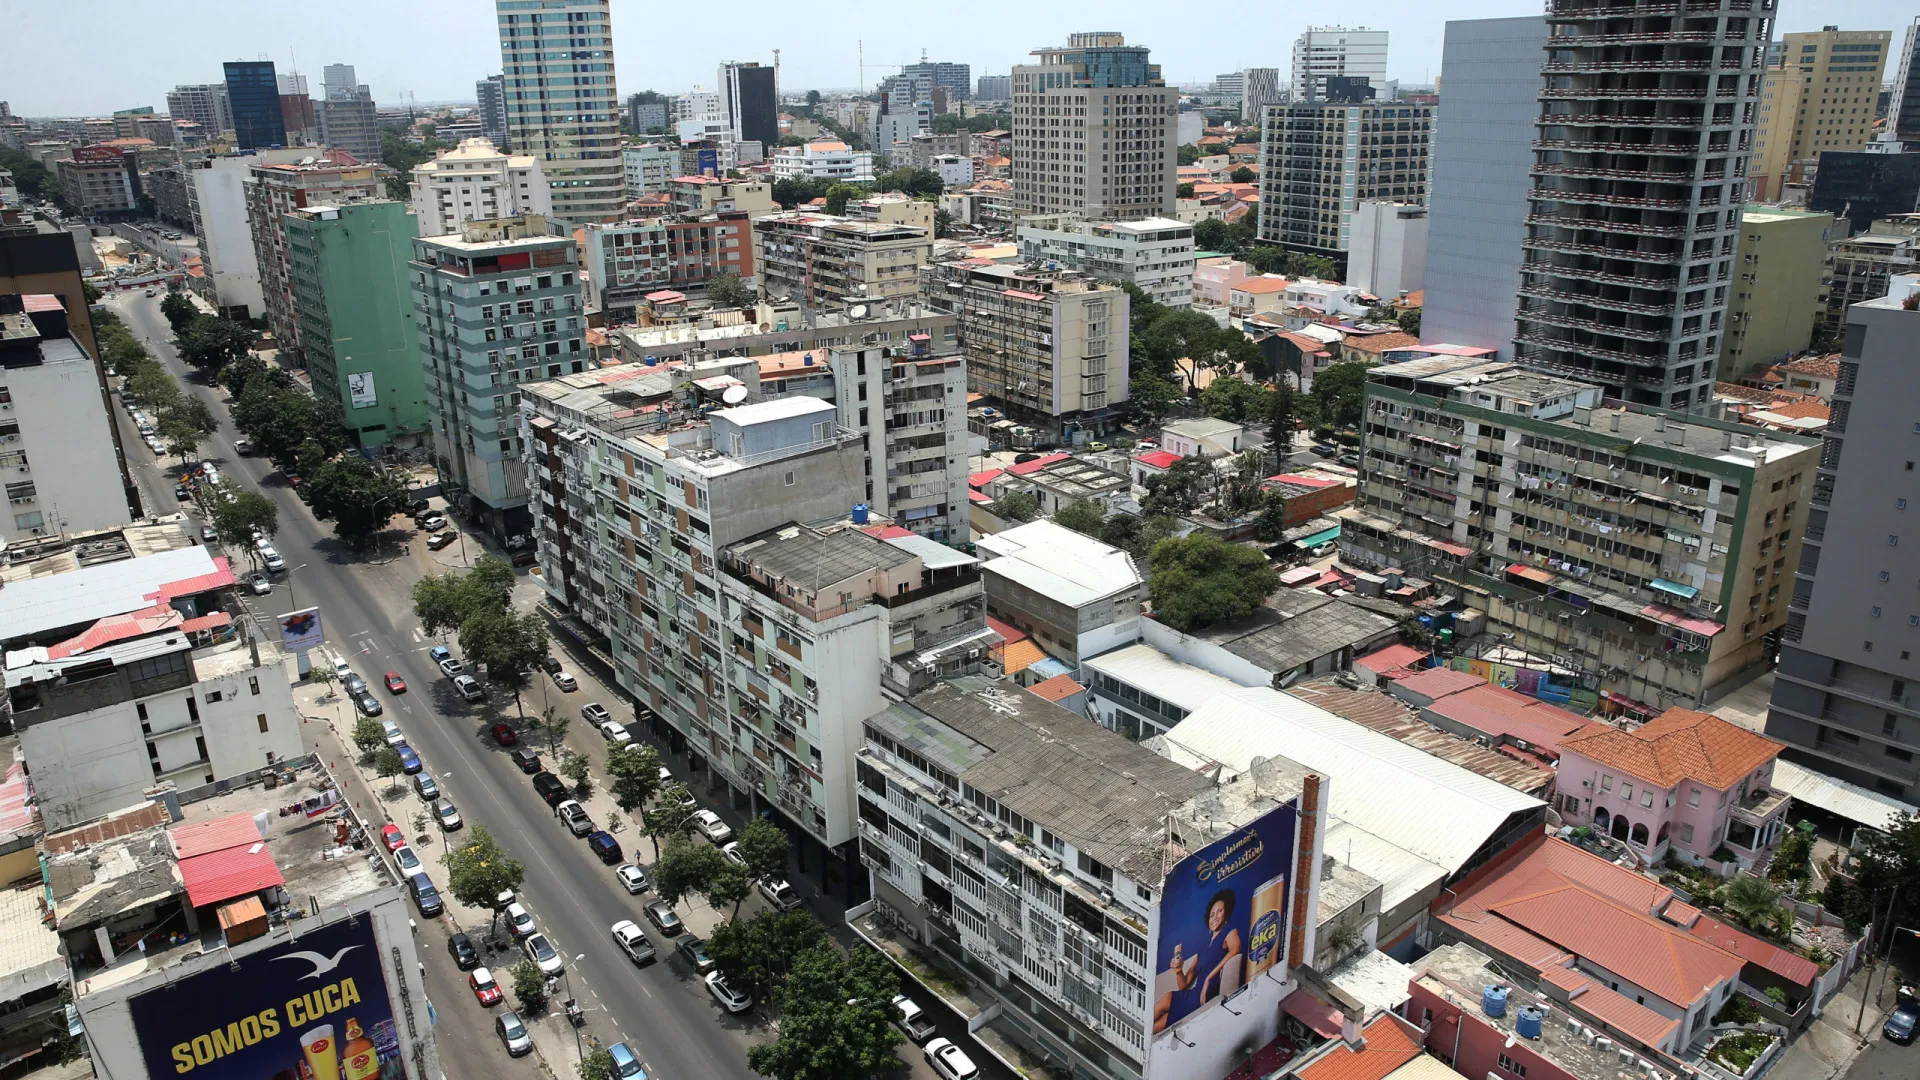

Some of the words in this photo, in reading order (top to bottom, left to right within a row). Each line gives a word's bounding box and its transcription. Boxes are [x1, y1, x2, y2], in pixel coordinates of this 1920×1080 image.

[1350, 78, 1367, 86] ELITE
[171, 1008, 280, 1074] SOMOS
[285, 977, 361, 1028] CUCA
